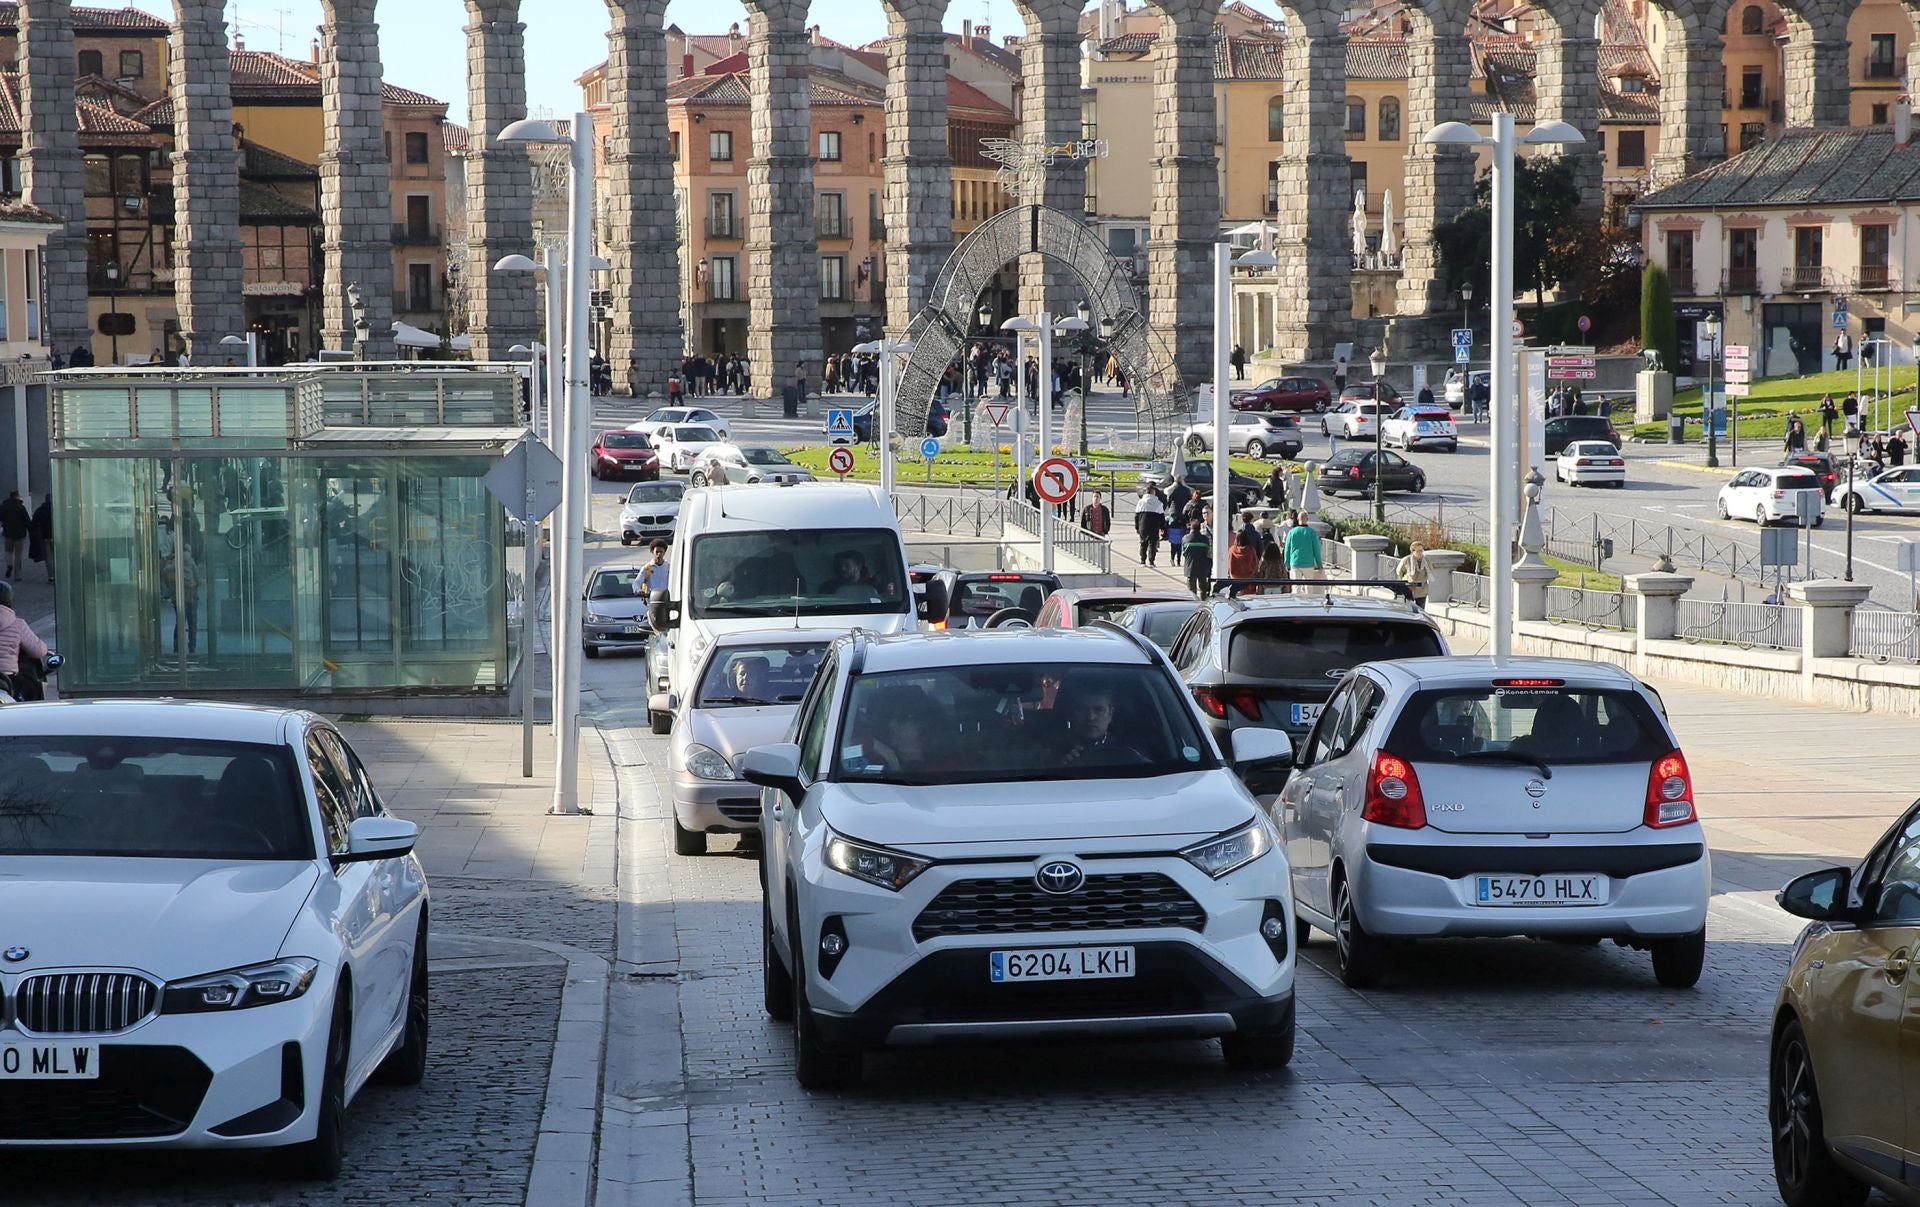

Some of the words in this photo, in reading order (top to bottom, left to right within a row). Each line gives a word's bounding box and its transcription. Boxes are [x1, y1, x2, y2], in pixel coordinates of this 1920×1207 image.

[1431, 803, 1465, 812] PIXO
[1491, 879, 1546, 899] 5470
[1556, 879, 1593, 899] HLX
[1008, 952, 1072, 977] 6204
[1081, 950, 1129, 974] LKH
[33, 1047, 89, 1074] MLW
